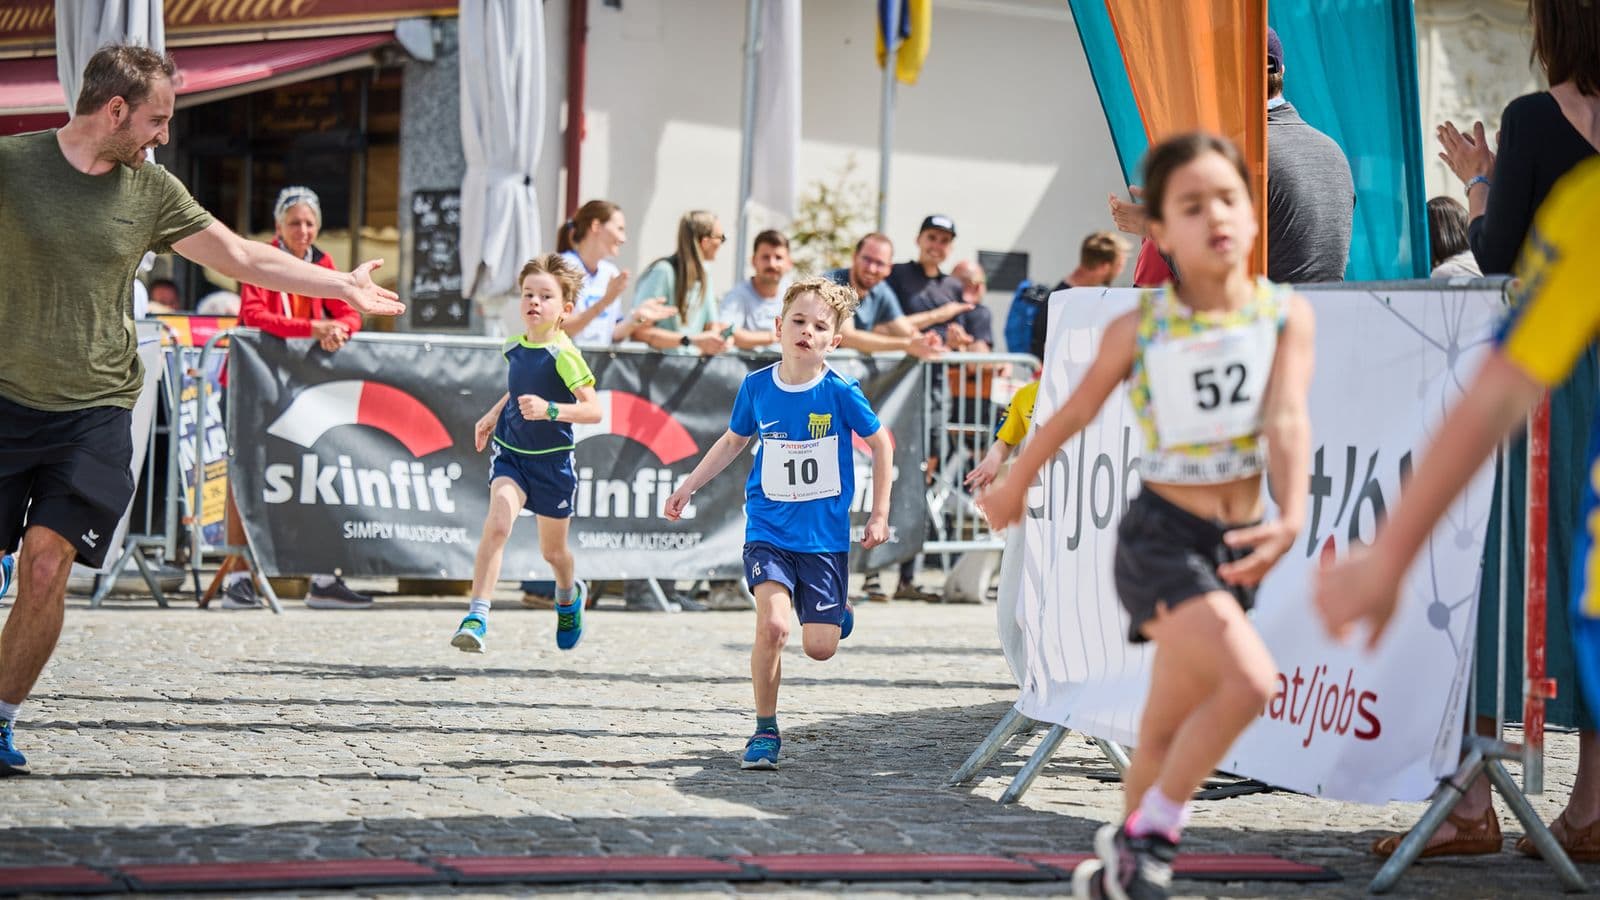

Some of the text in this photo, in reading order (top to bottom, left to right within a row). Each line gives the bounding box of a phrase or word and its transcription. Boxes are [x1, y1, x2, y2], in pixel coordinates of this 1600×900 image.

[1193, 363, 1250, 411] 52
[783, 458, 819, 485] 10
[343, 521, 393, 539] SIMPLY
[577, 532, 623, 549] SIMPLY
